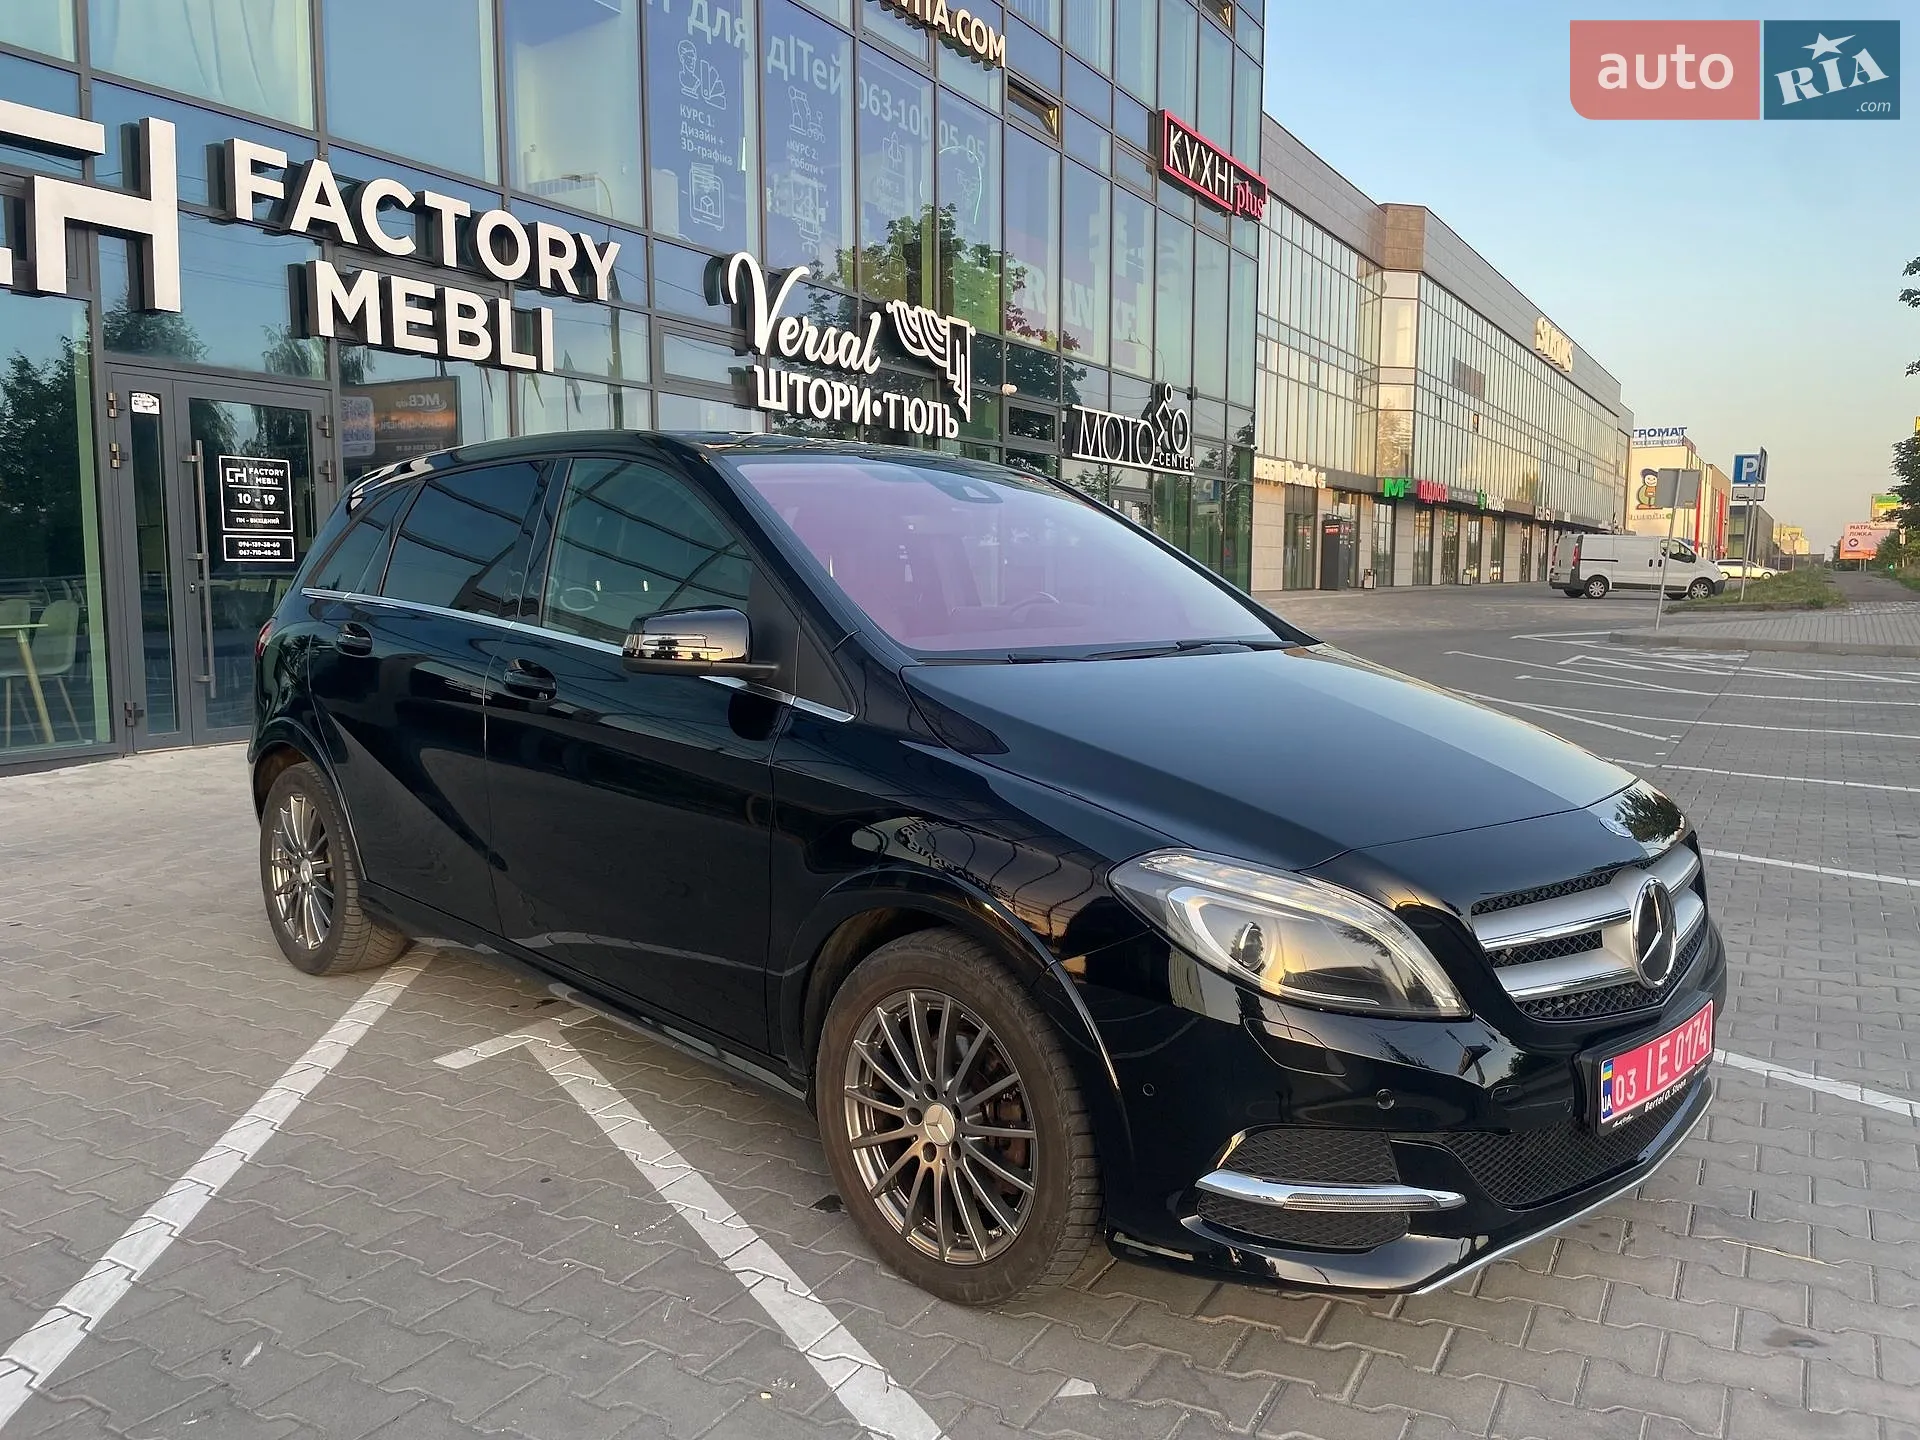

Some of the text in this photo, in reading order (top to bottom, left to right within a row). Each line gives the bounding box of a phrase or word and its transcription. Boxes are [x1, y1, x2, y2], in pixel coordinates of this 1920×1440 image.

[680, 103, 705, 124] КУРС
[681, 120, 717, 145] Дизайн
[681, 137, 733, 166] 3D-графіка
[1169, 124, 1265, 220] КУХНІ plus
[233, 138, 621, 301] FACTORY
[314, 260, 554, 373] MEBLI
[728, 252, 882, 375] Versal
[248, 467, 285, 477] FACTORY
[255, 477, 278, 485] MEBLI
[1741, 457, 1758, 480] P
[237, 493, 252, 504] 10
[262, 494, 276, 505] 19
[1615, 1011, 1708, 1107] 03 IE 0174
[1602, 1095, 1613, 1113] UA
